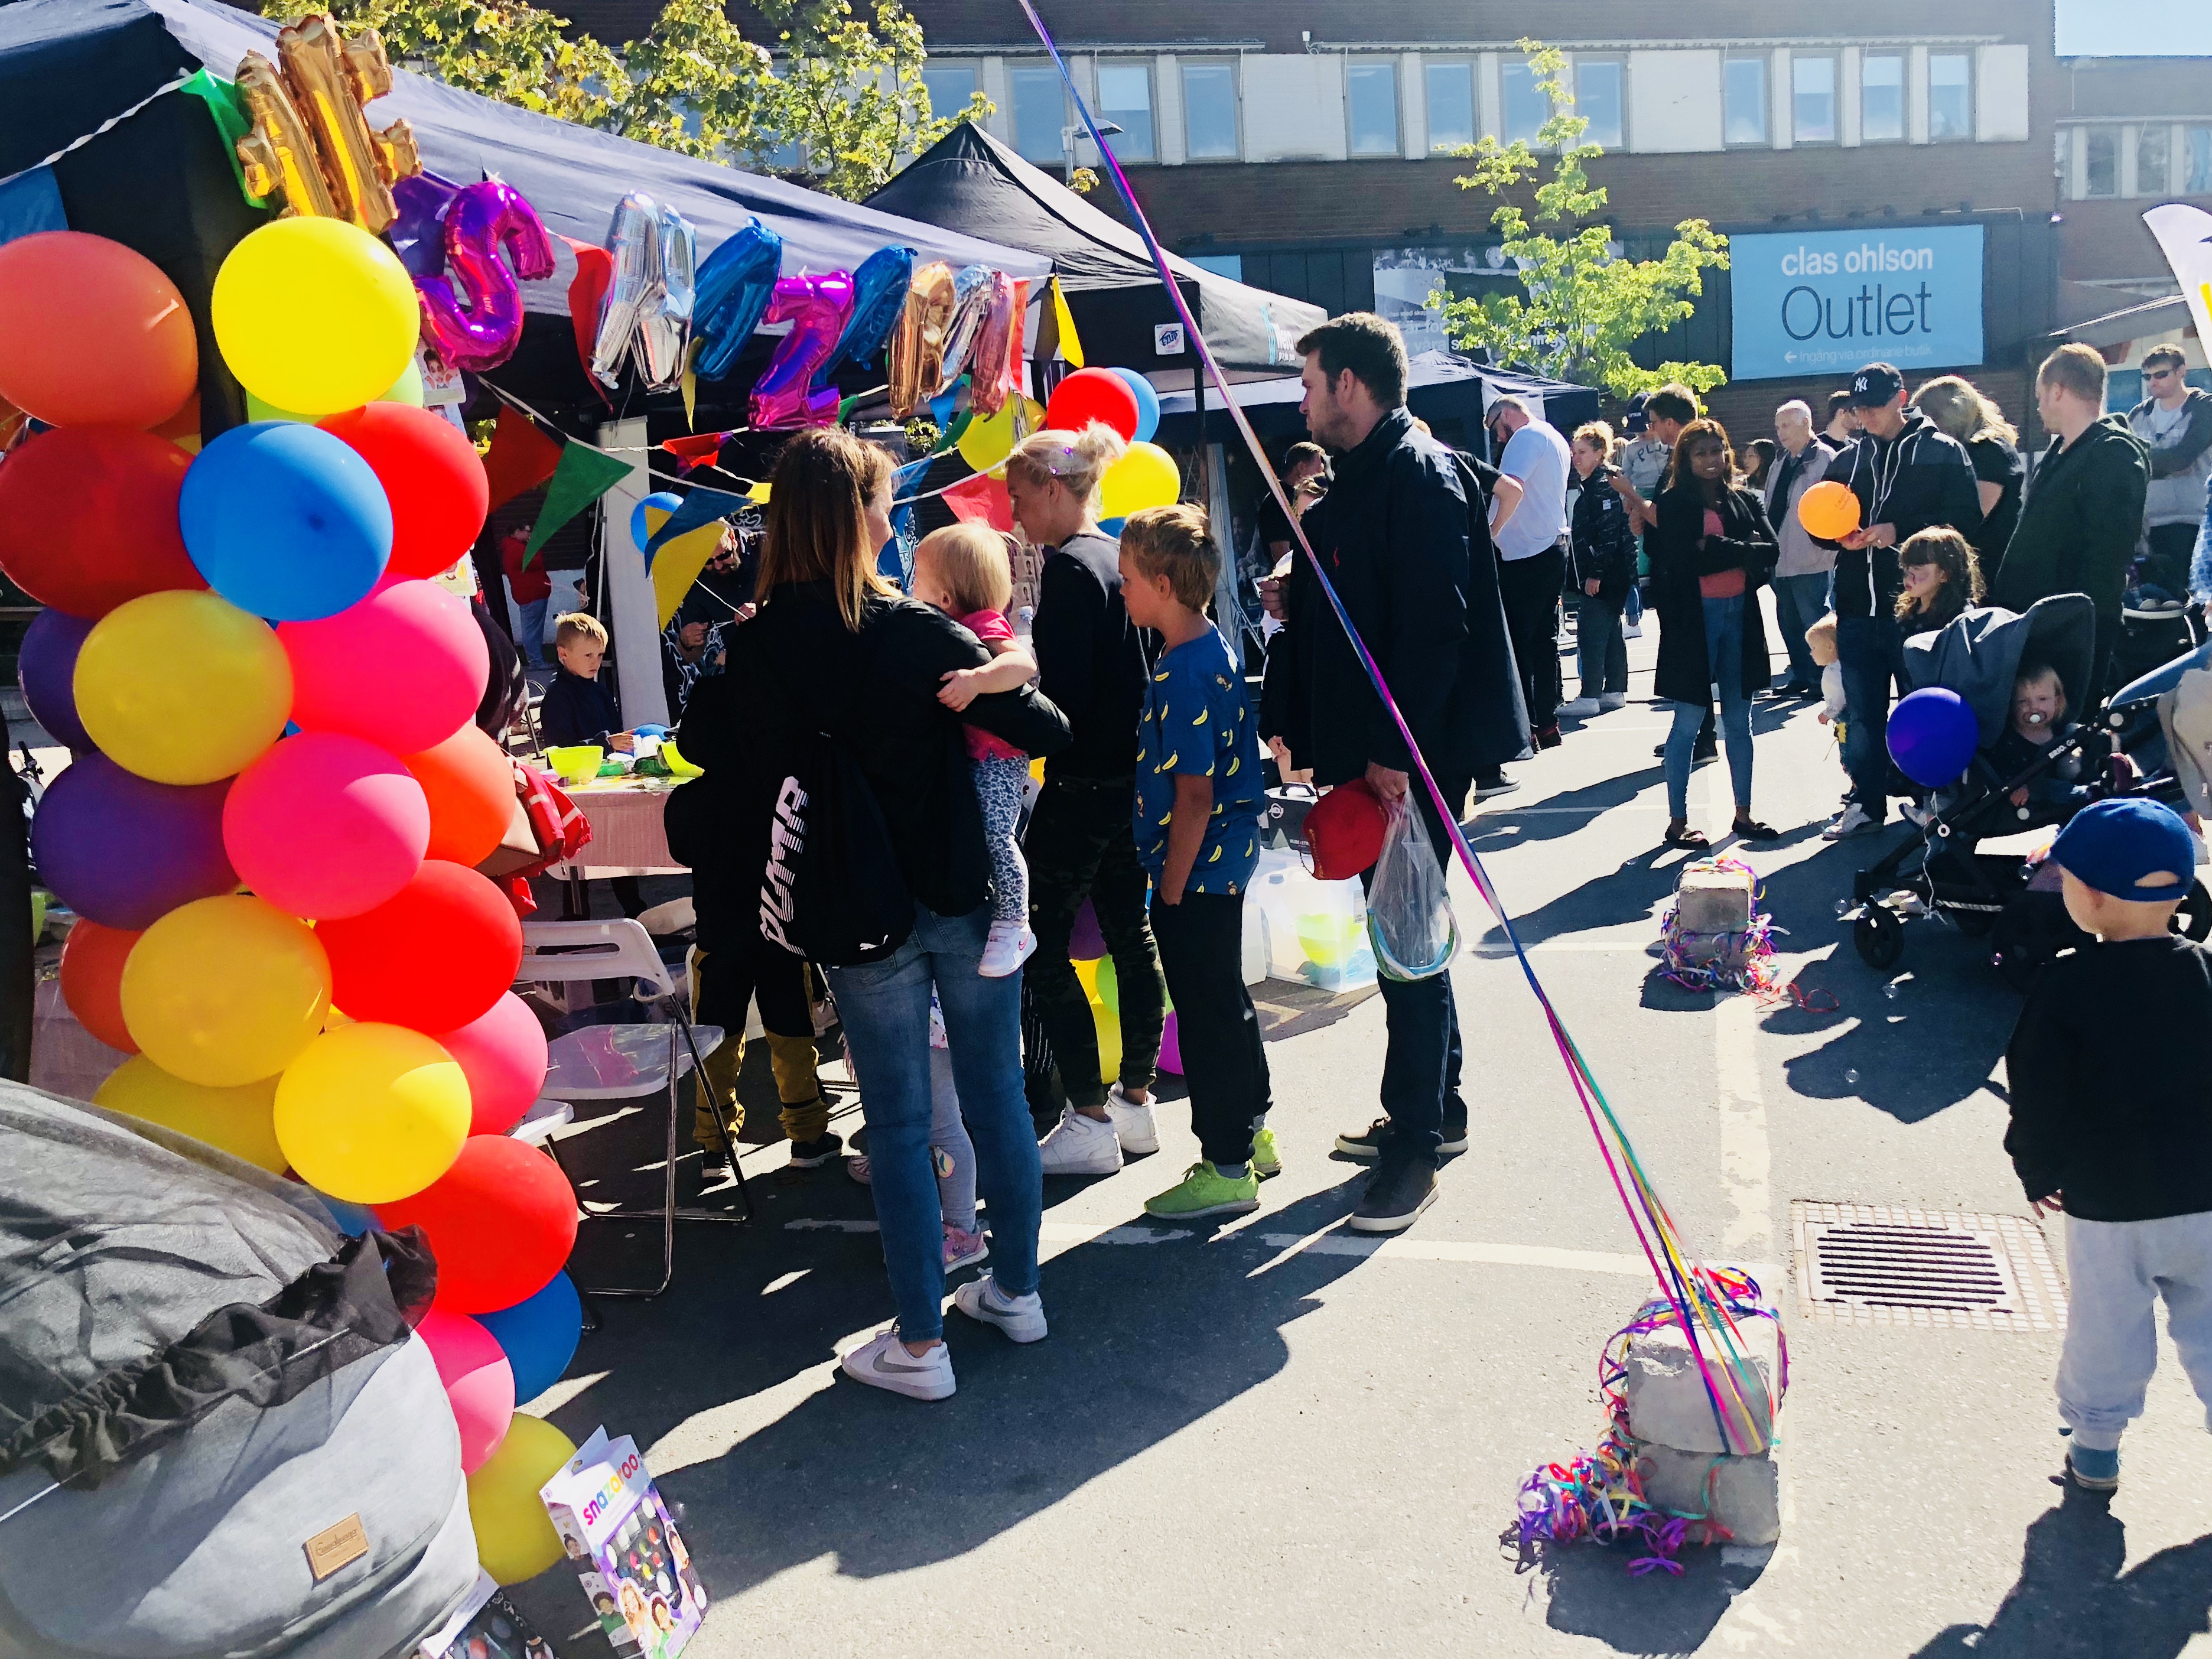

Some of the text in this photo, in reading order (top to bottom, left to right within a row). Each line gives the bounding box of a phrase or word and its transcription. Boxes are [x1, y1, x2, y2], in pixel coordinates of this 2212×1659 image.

[1781, 242, 1933, 276] clas ohlson
[1781, 281, 1932, 341] Outlet
[1800, 343, 1933, 364] Ingång via ordinarie butik
[583, 1453, 639, 1525] snazaroo
